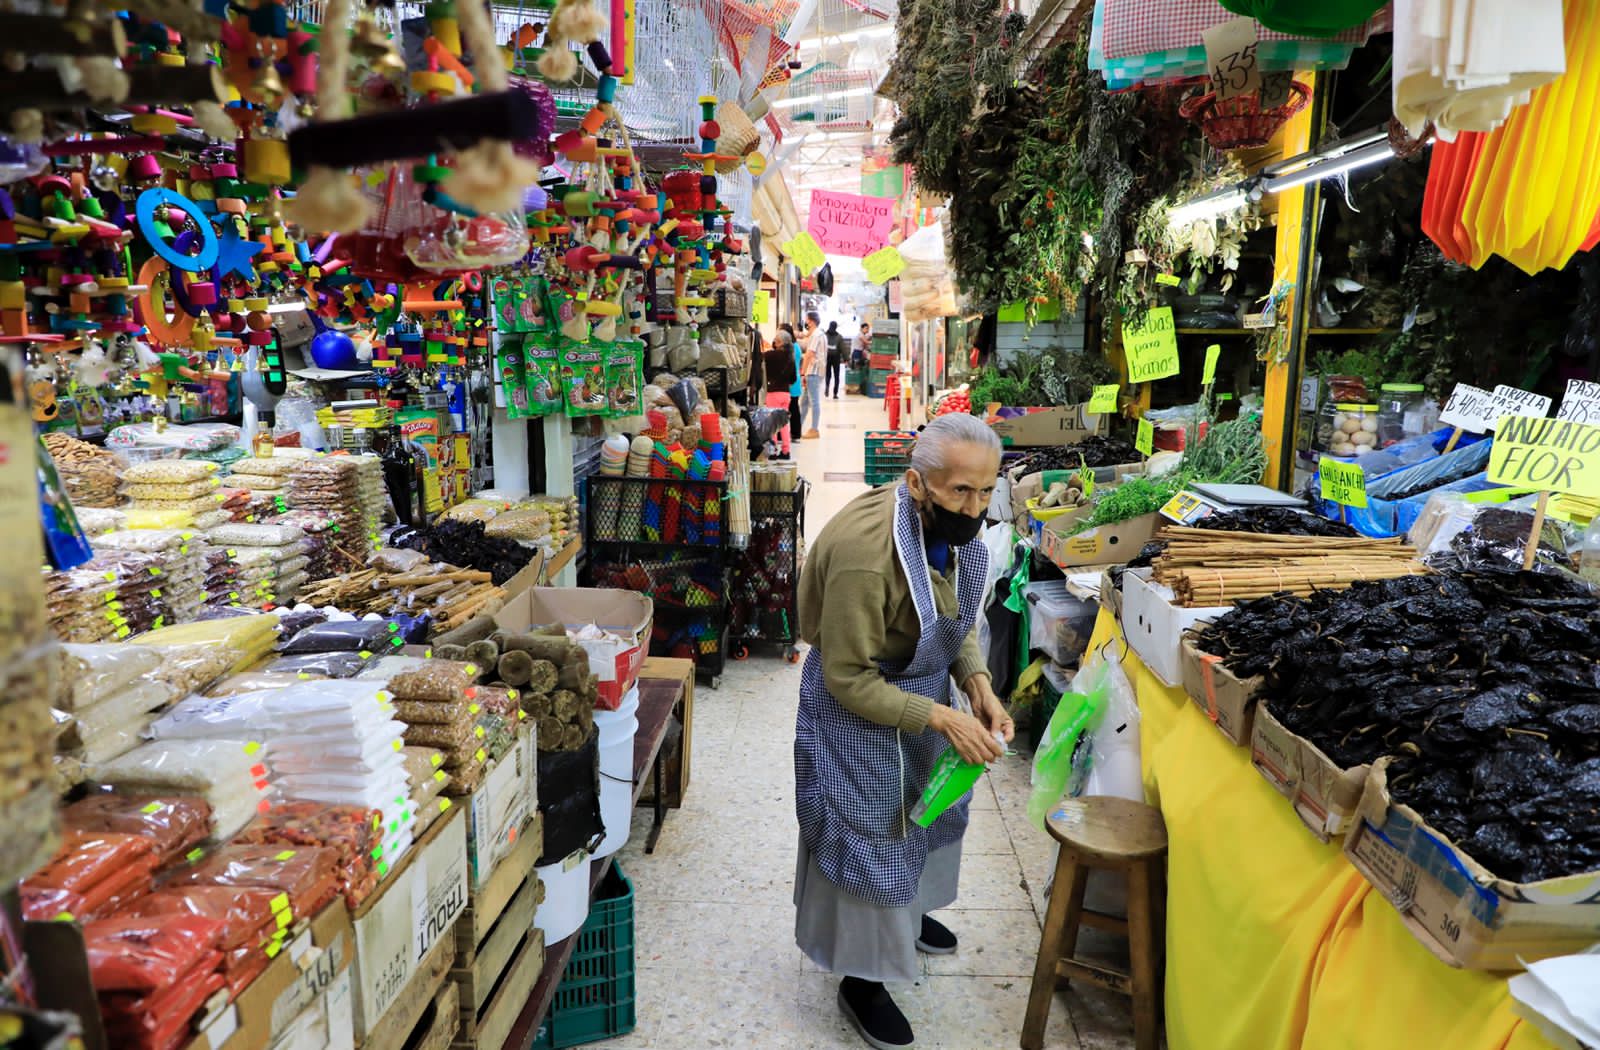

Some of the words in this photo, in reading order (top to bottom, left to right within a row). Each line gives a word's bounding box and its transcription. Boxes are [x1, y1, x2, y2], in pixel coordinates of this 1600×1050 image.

[1213, 41, 1258, 97] $35
[812, 189, 888, 216] Renovadora
[1134, 340, 1160, 359] para
[1491, 396, 1521, 413] PASA
[1496, 416, 1600, 454] MULATO
[1439, 912, 1461, 943] 360
